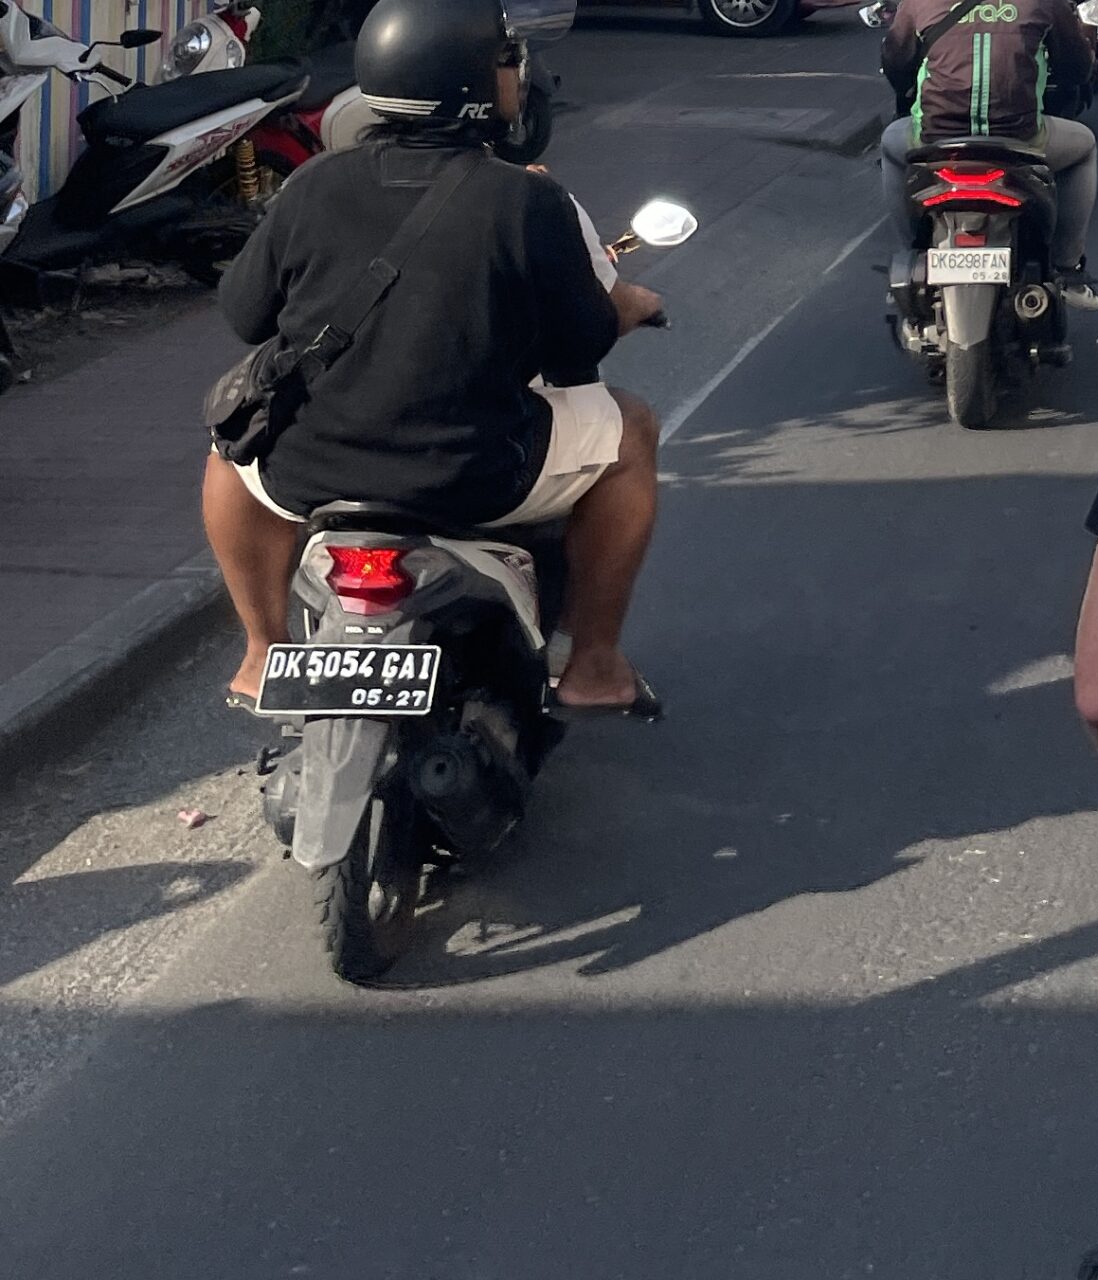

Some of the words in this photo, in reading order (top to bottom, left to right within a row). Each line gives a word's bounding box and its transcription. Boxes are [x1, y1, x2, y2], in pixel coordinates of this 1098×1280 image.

[267, 651, 306, 679] DK
[306, 650, 376, 678] 5054
[381, 651, 433, 680] GAI
